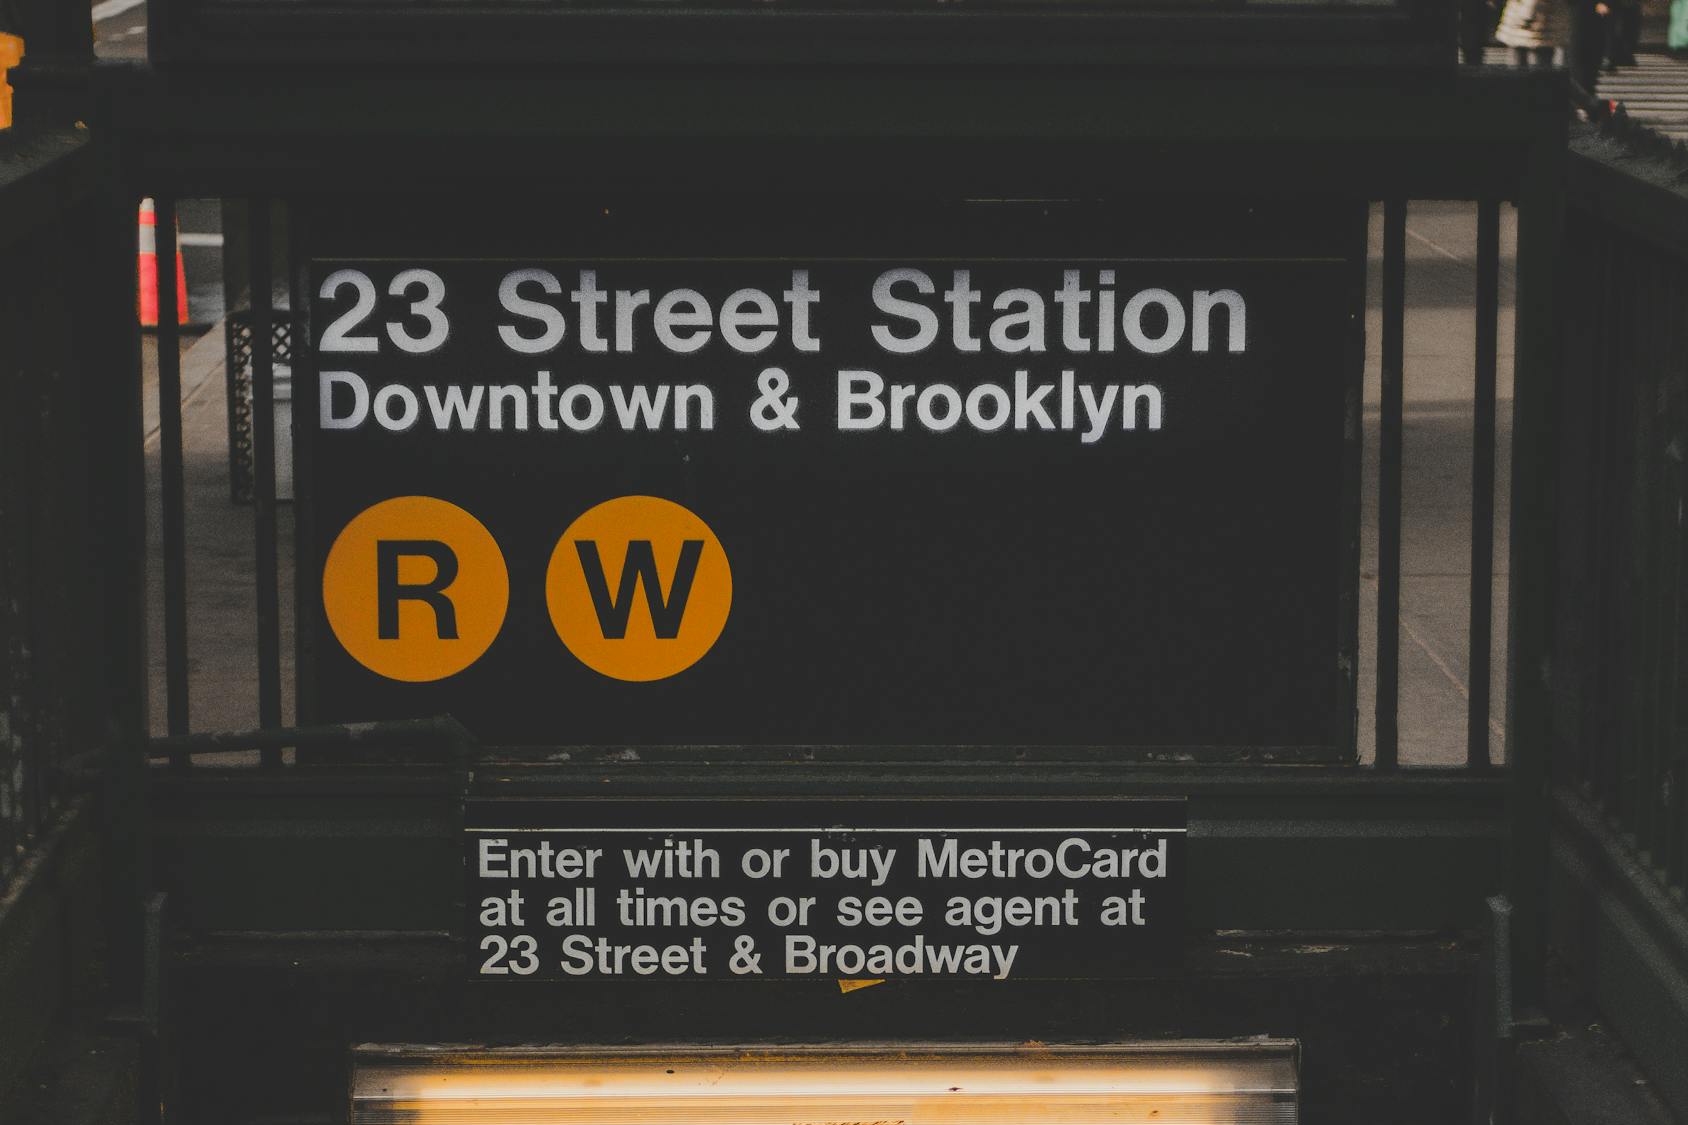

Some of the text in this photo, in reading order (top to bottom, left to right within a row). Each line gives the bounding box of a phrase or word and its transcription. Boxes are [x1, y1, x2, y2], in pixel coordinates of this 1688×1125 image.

[319, 269, 1246, 354] 23 Street Station
[320, 368, 1164, 443] Downtown & Brooklyn
[375, 540, 706, 640] R W
[479, 838, 1167, 886] Enter with or buy MetroCard
[480, 888, 1145, 935] at all times or see agent at
[480, 934, 1019, 979] 23 Street & Broadway
